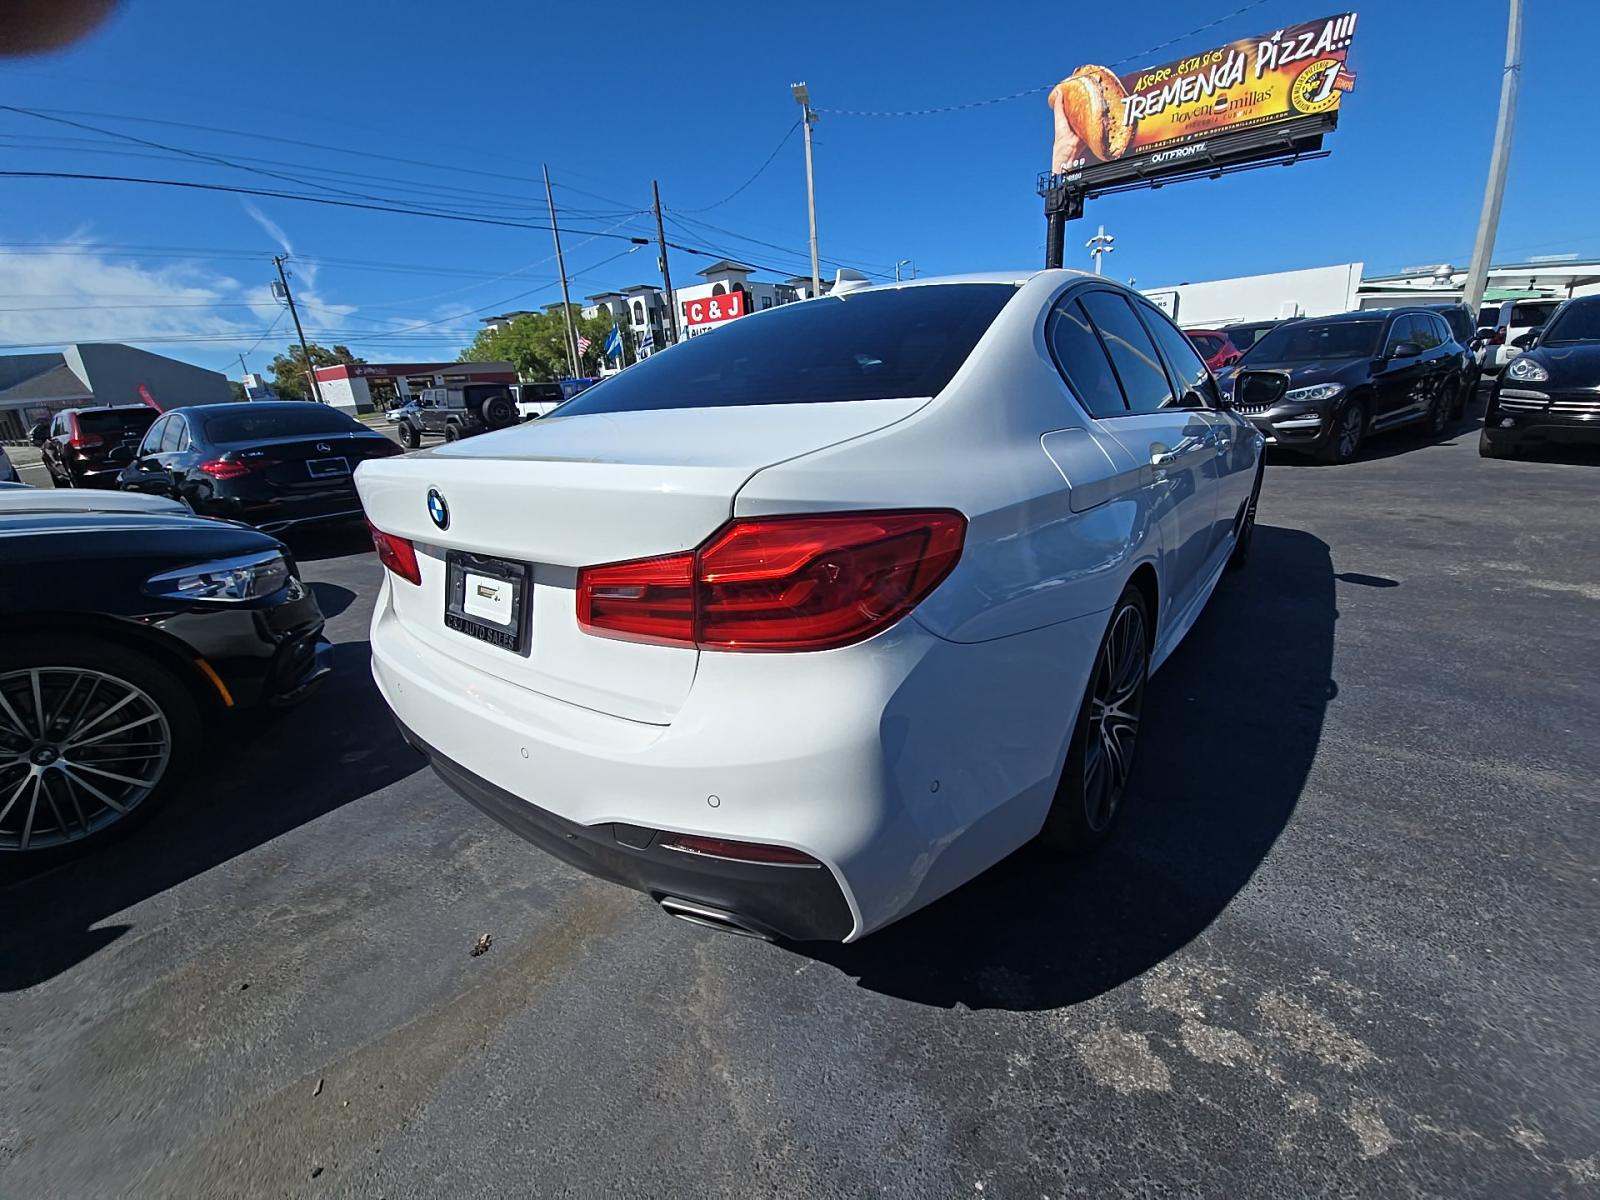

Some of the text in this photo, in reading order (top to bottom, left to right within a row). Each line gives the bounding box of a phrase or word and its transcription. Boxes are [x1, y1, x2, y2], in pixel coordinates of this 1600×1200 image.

[691, 296, 739, 322] C & J
[464, 620, 486, 641] AUTO
[487, 627, 514, 650] SALES
